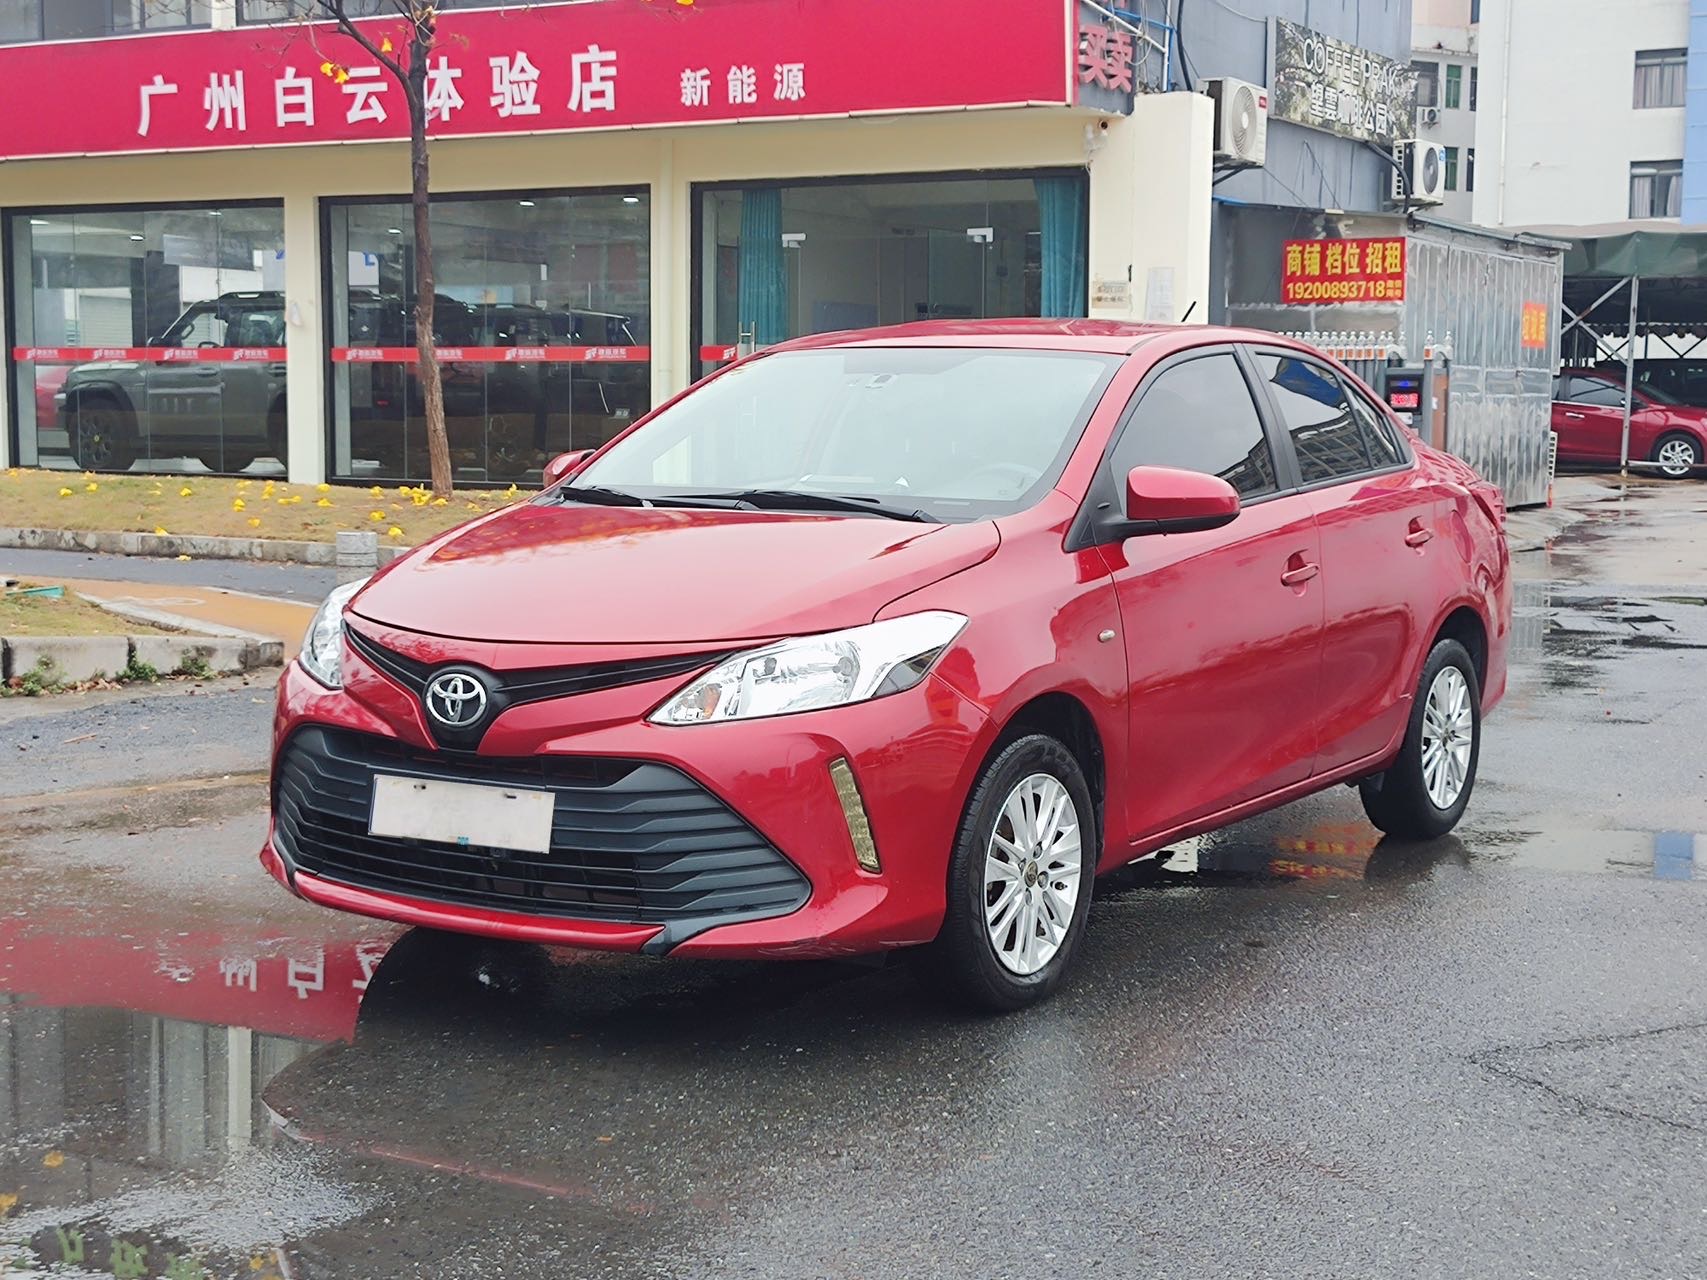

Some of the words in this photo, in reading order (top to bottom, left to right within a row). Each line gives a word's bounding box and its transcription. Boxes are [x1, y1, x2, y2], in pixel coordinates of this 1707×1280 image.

[137, 44, 617, 137] 广州白云体验店
[680, 62, 806, 107] 新能源
[1303, 38, 1361, 87] COFFEE
[1361, 58, 1398, 98] PRAK
[1286, 243, 1321, 276] 商铺
[1326, 242, 1360, 276] 档位
[1366, 241, 1402, 274] 招租
[1287, 281, 1385, 299] 19200893718
